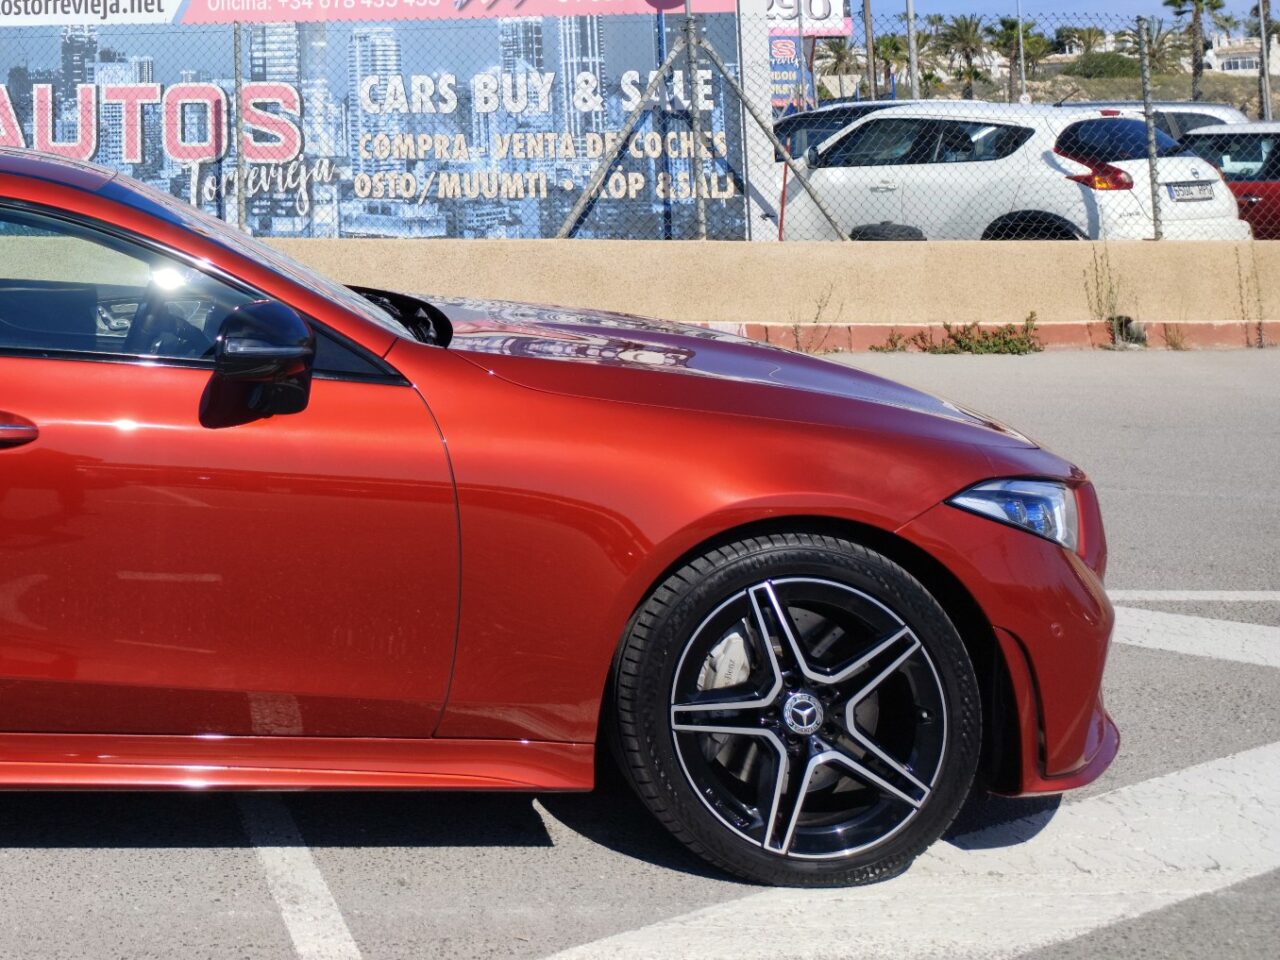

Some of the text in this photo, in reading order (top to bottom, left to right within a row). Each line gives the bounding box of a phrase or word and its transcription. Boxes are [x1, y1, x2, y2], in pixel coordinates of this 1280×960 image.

[360, 69, 714, 114] CARS BUY & SALE
[359, 133, 469, 159] COMPRA
[495, 132, 576, 159] VENTA
[586, 132, 618, 158] DE
[629, 131, 727, 159] COCHES
[182, 154, 336, 215] Torrevieja
